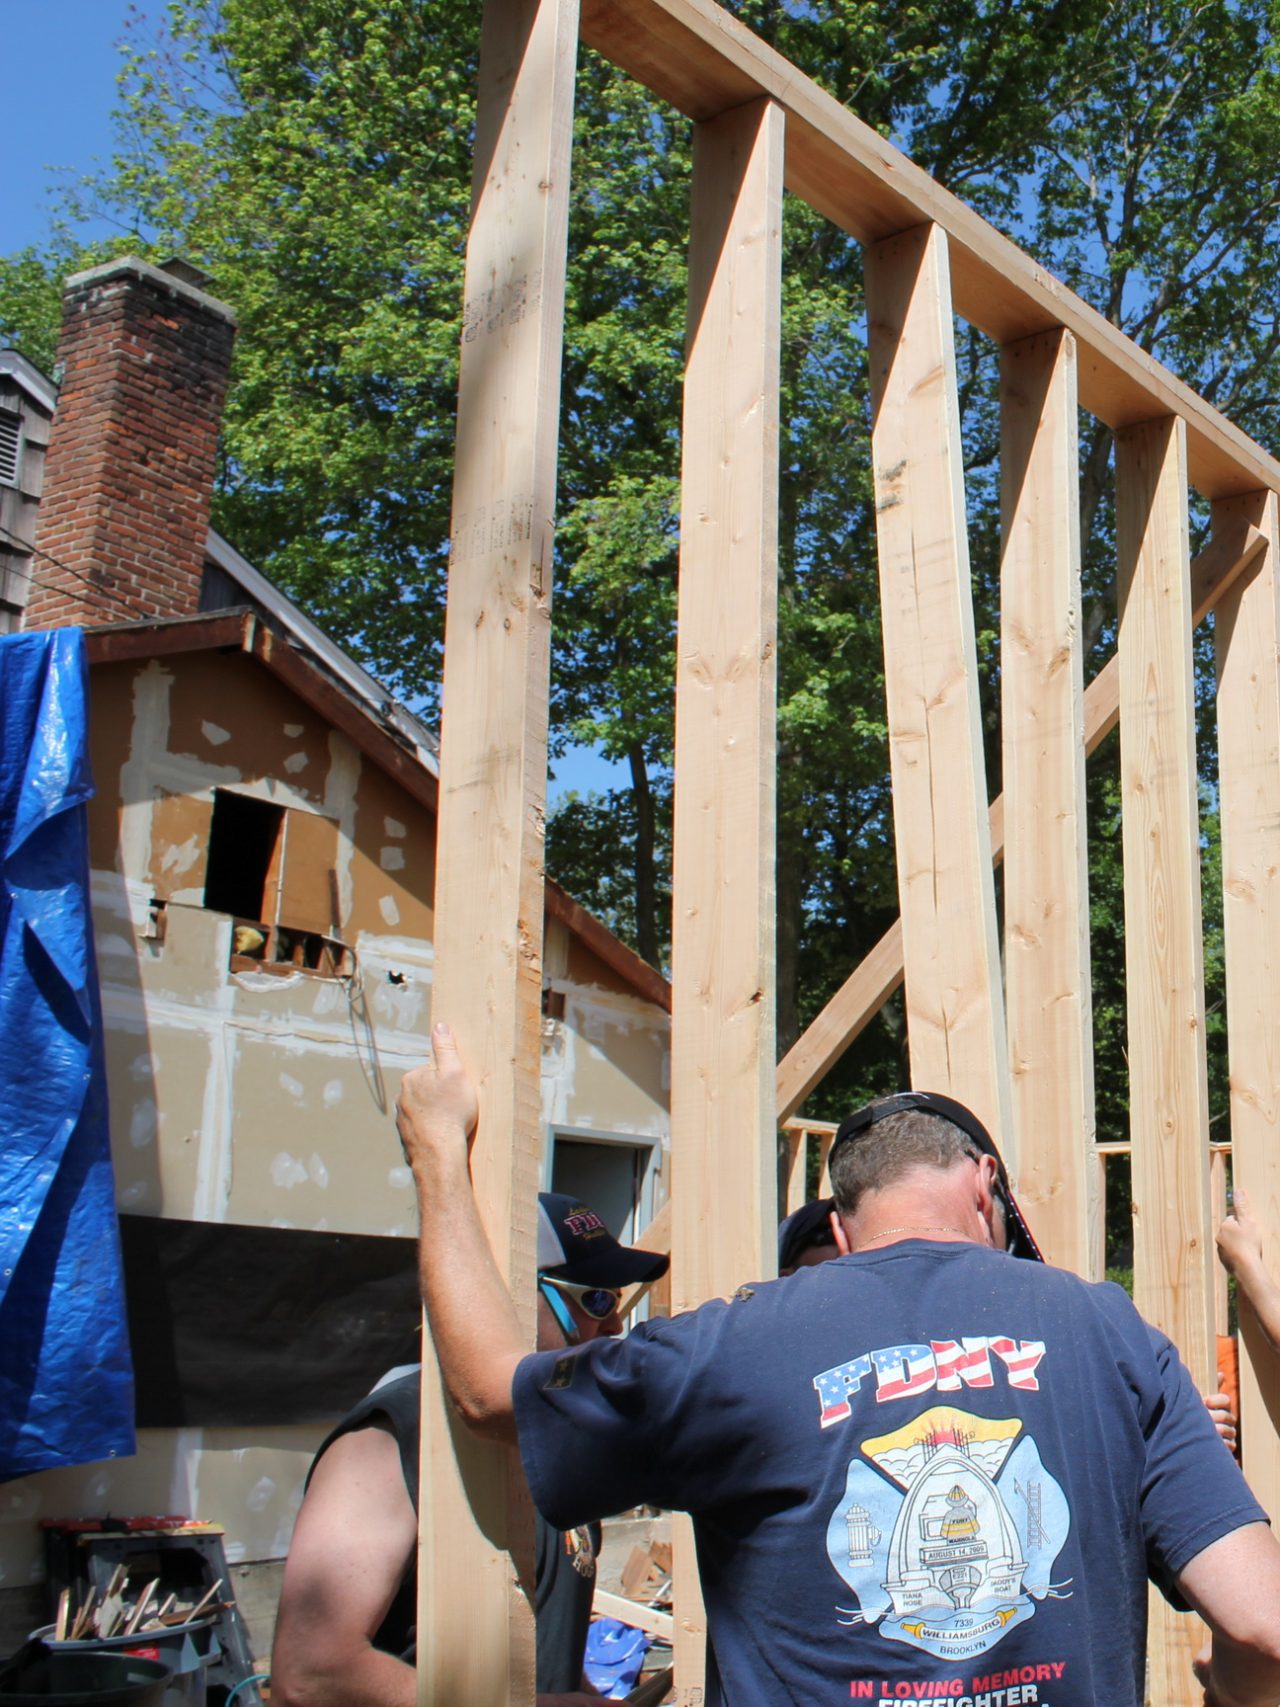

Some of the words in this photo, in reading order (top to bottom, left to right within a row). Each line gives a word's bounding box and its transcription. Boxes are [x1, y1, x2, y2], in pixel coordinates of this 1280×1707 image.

[812, 1335, 1046, 1430] FDNY
[928, 1549, 956, 1559] AUGUST
[922, 1619, 1001, 1639] WILLIAMSBURG
[954, 1618, 974, 1629] 7339
[939, 1640, 986, 1655] BROOKLYN
[850, 1681, 873, 1698] IN
[881, 1680, 964, 1698] LOVING
[972, 1661, 1066, 1694] MEMORY
